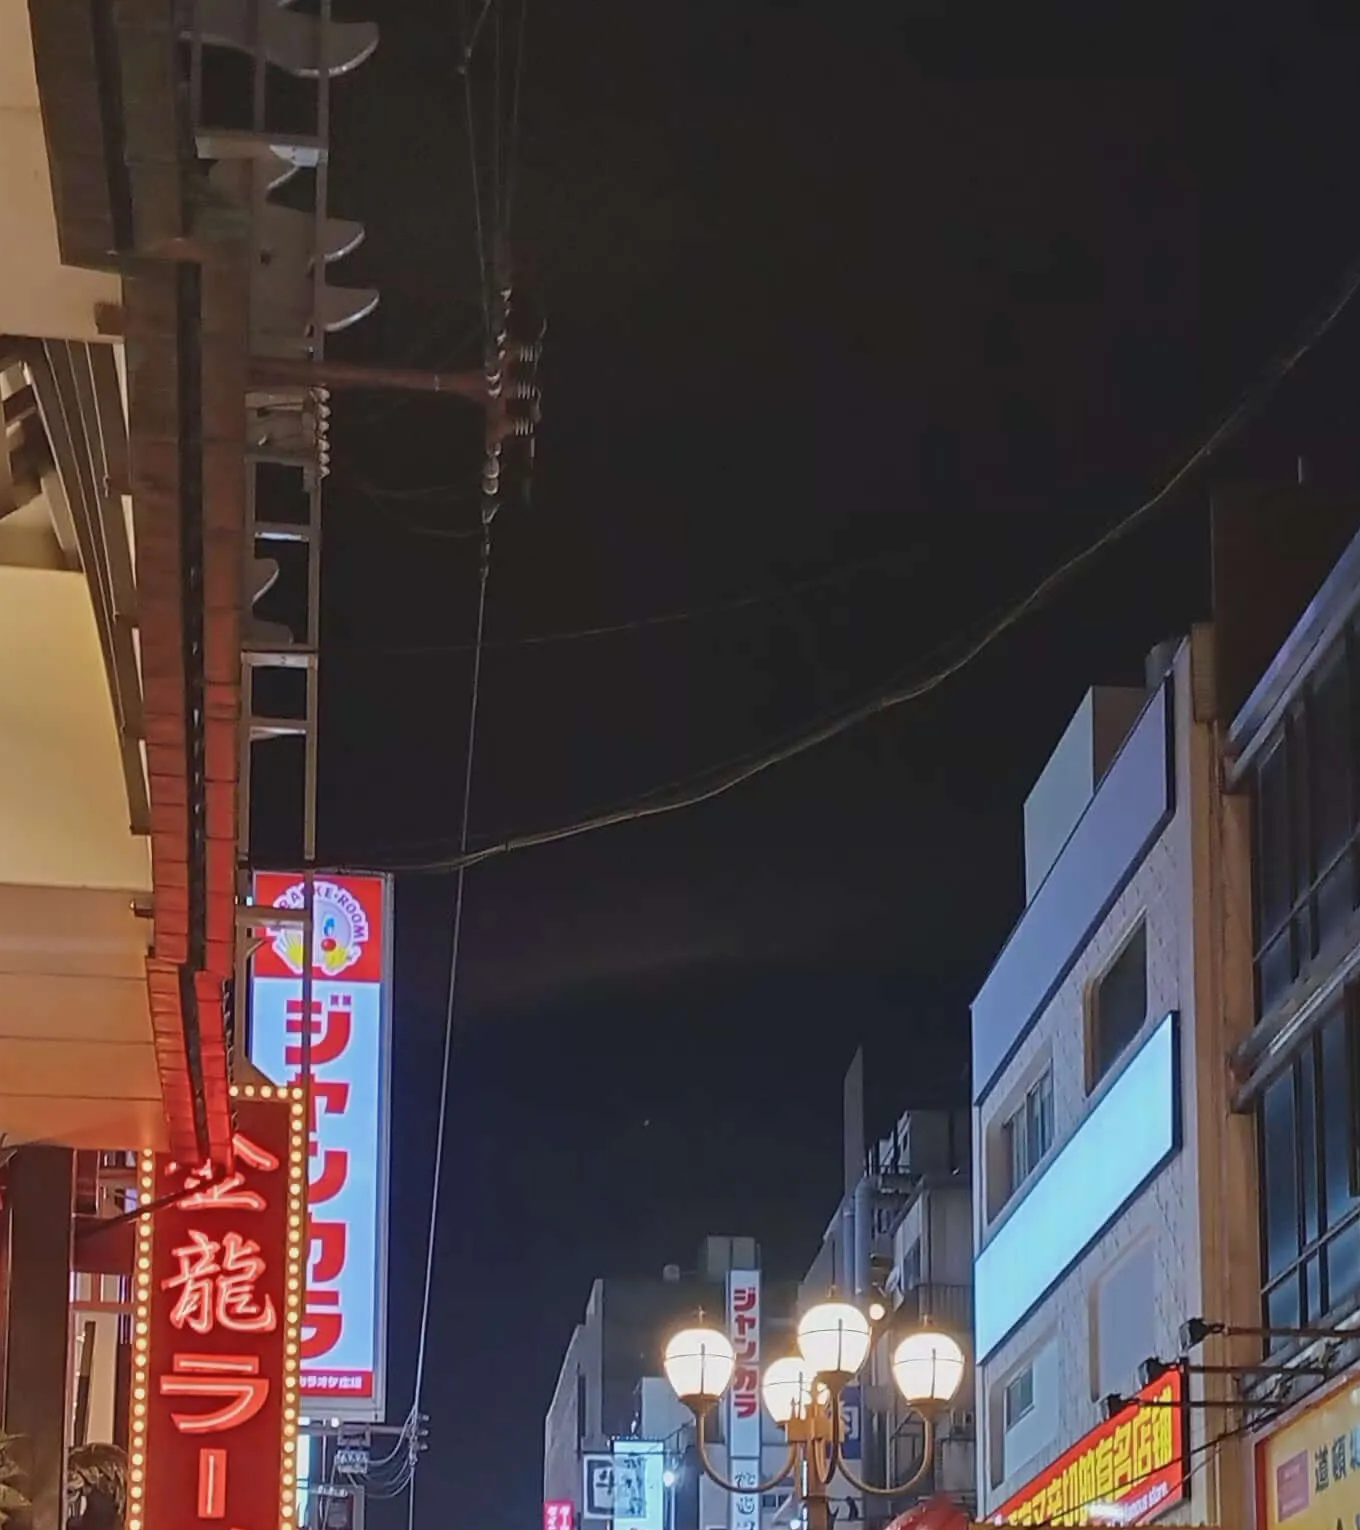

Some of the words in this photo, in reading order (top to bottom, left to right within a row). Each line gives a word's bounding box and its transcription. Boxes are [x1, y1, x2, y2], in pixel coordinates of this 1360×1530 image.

[733, 1287, 758, 1418] ジャンカラ
